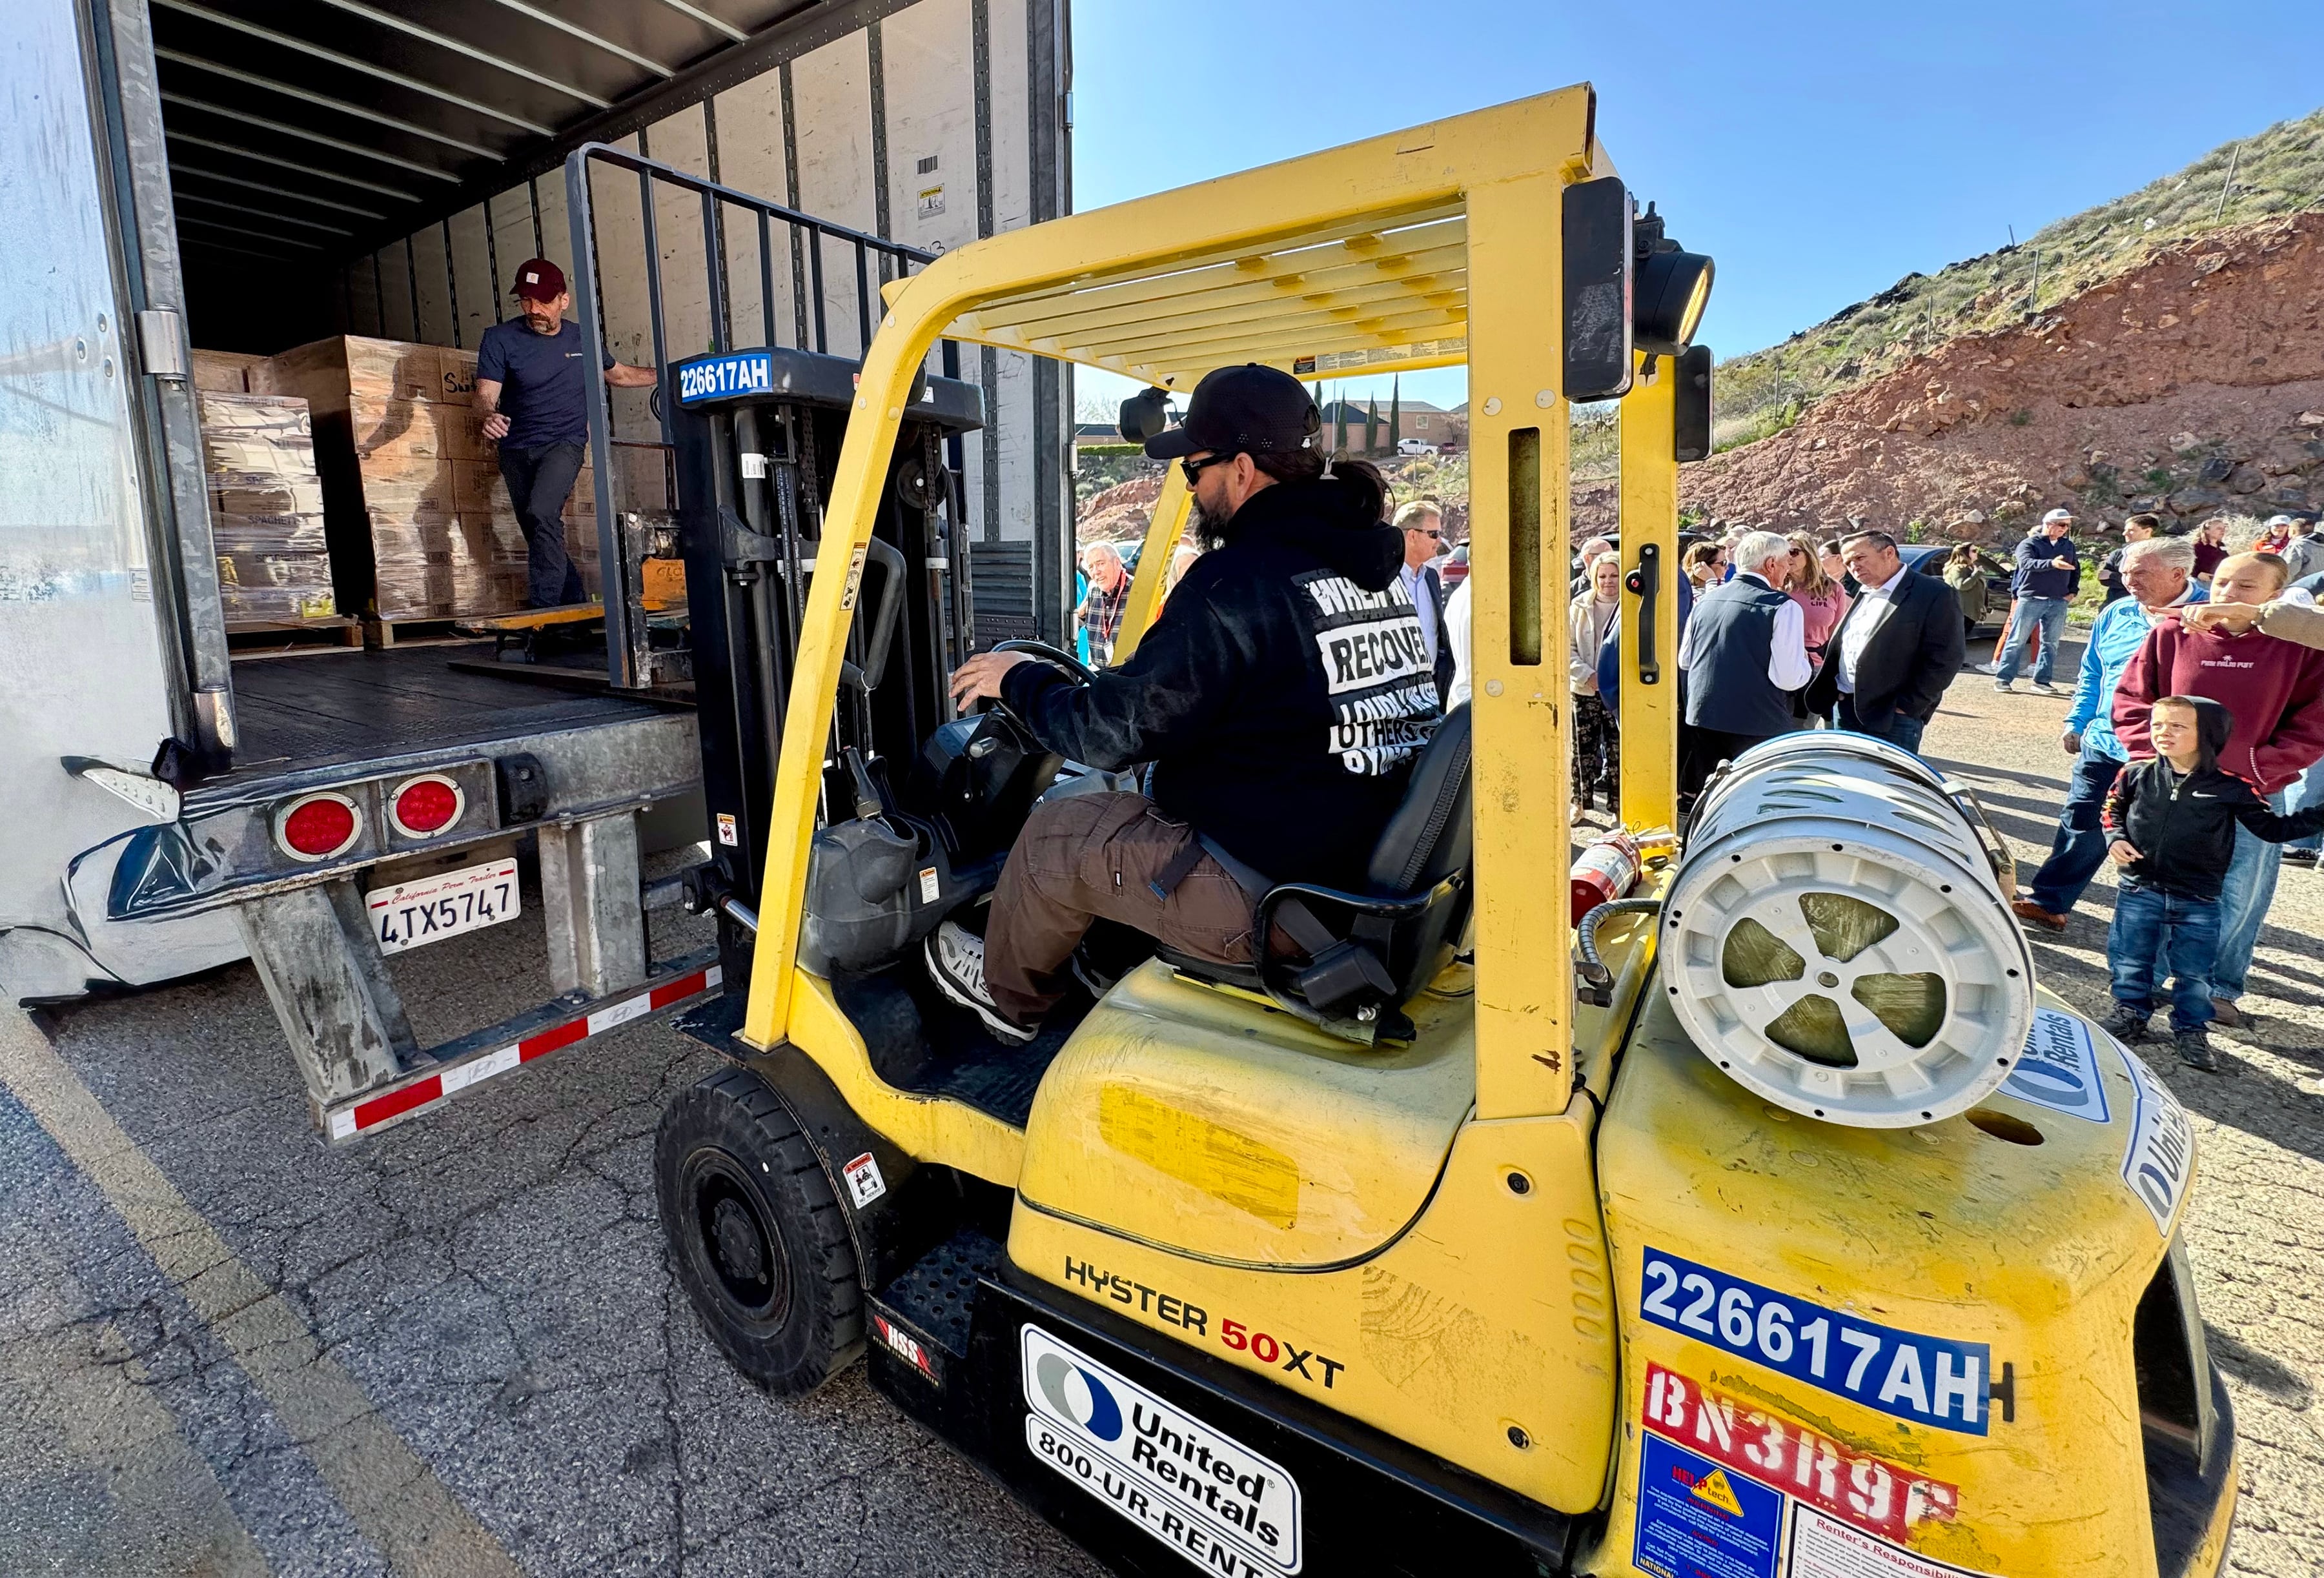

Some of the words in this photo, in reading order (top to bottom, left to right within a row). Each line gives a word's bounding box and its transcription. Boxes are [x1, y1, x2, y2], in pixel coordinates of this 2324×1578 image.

[680, 359, 768, 398] 226617AH
[381, 883, 509, 943] 4TX5747
[391, 887, 438, 904] California
[441, 881, 464, 891] Perm
[469, 873, 497, 884] Trailer
[1065, 1255, 1208, 1337] HYSTER
[888, 1324, 919, 1364] HSS
[1643, 1260, 1979, 1423] 226617AH
[1132, 1401, 1267, 1504] United
[1038, 1431, 1263, 1578] 800-UR-RENT
[1132, 1435, 1280, 1547] Rentals
[1817, 1518, 1869, 1550] Renter's
